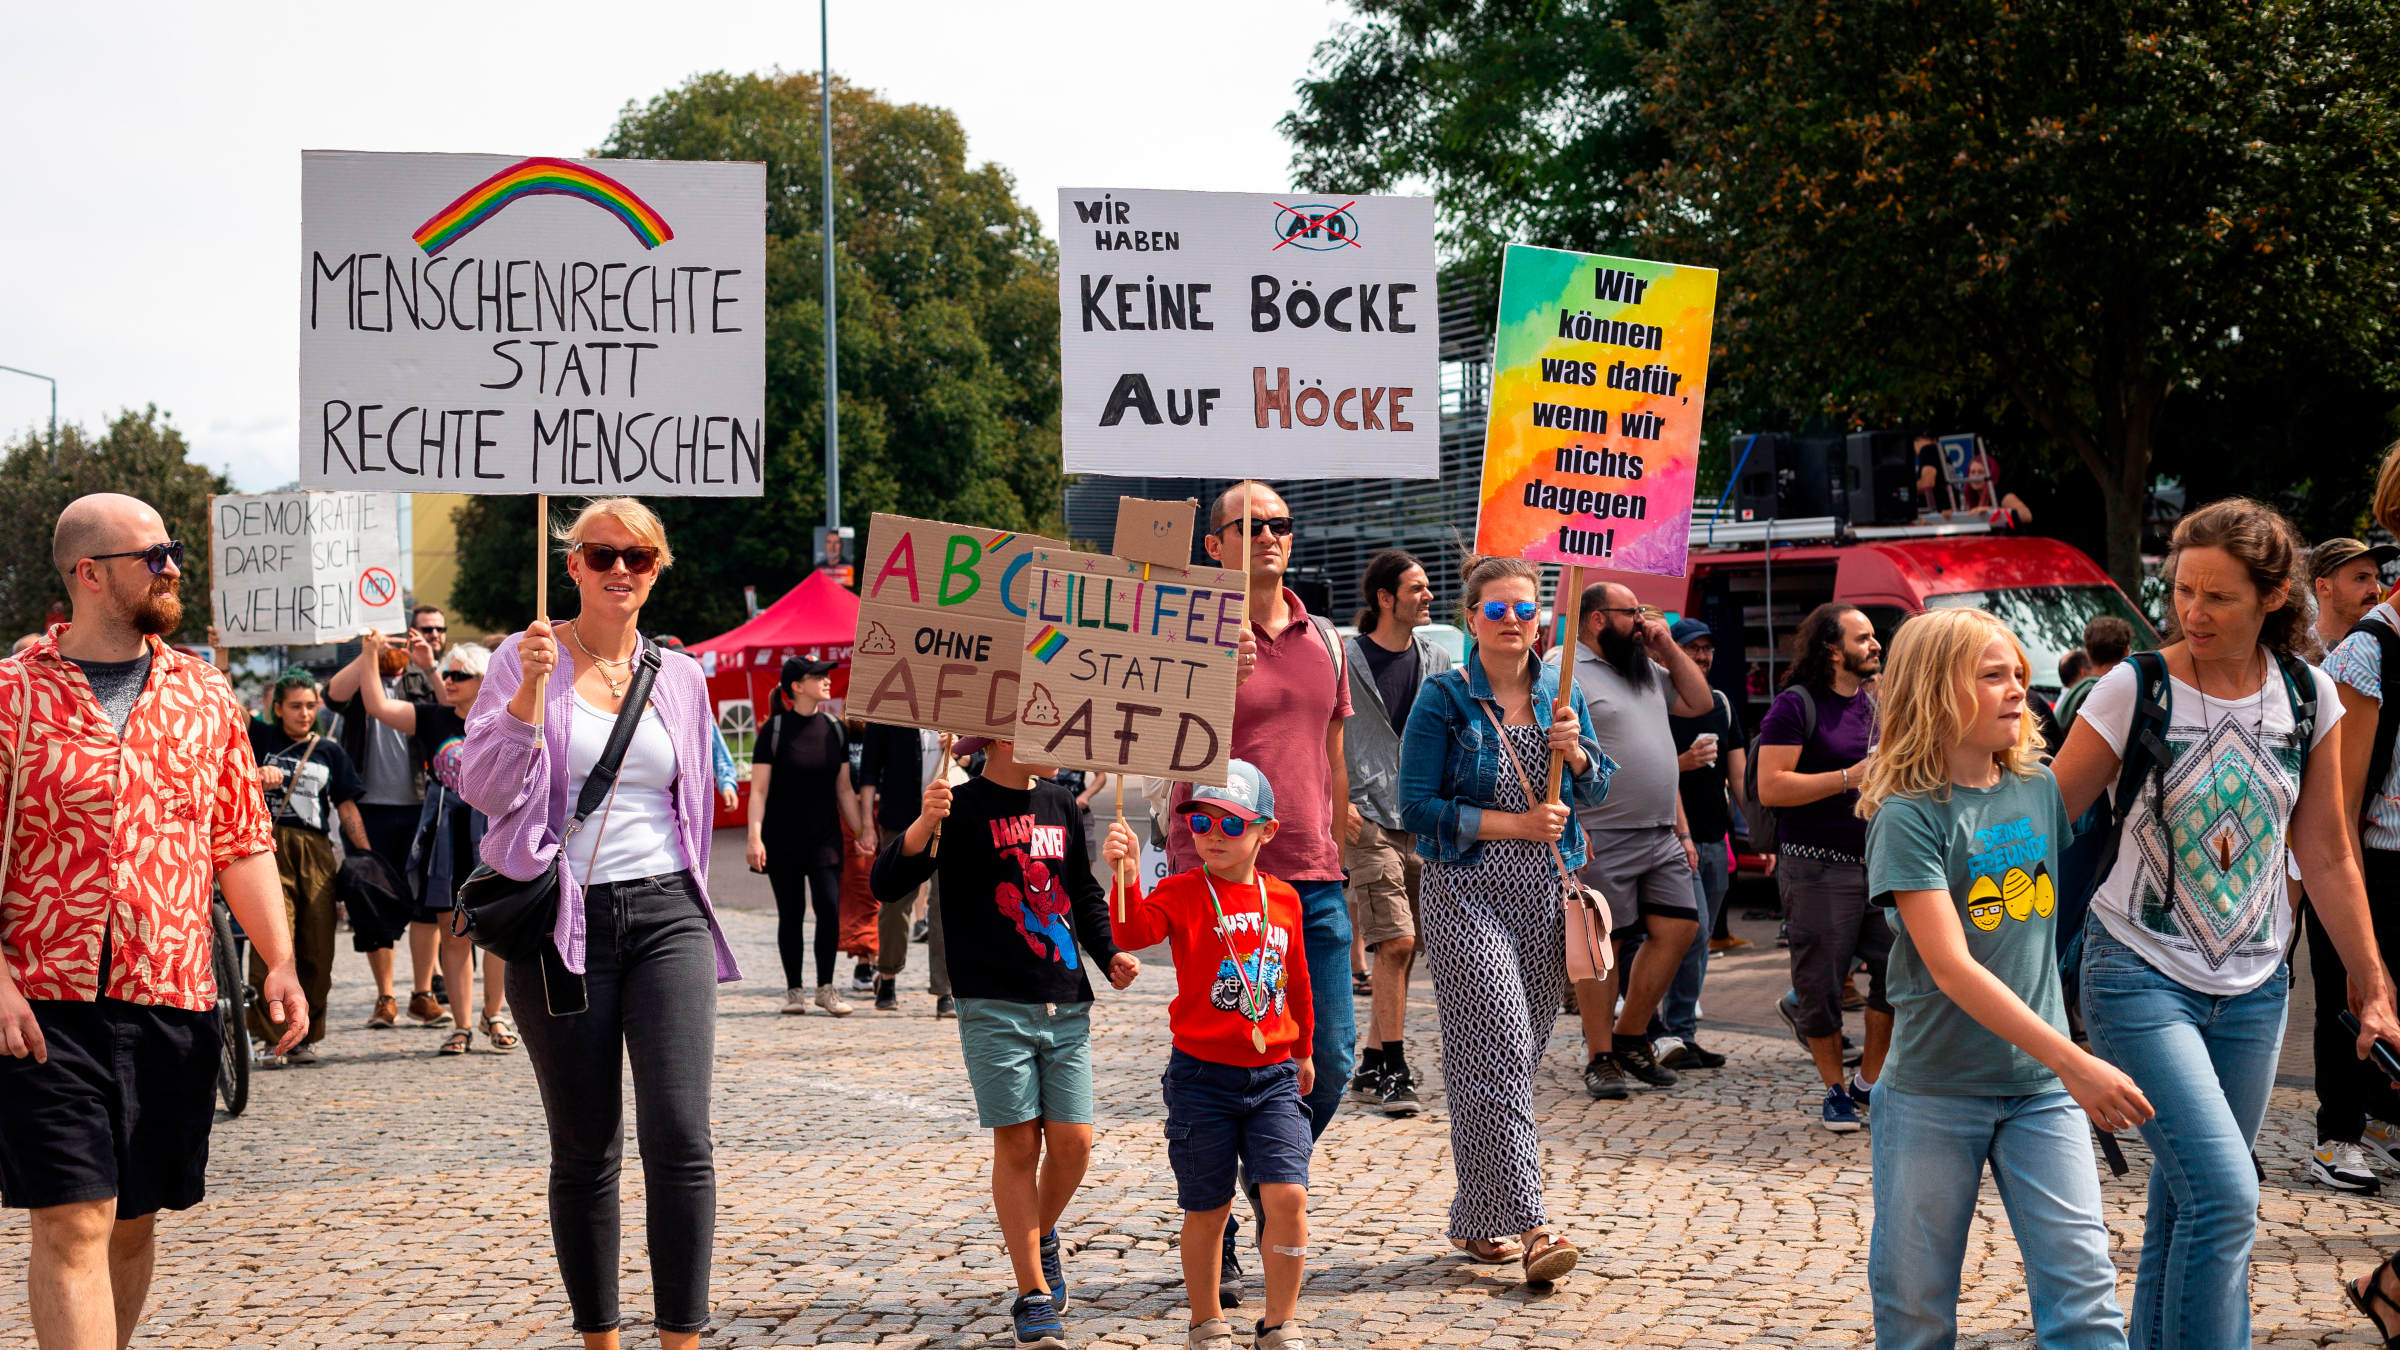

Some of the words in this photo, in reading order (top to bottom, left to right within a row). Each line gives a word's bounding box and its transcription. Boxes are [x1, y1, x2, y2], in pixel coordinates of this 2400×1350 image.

[1095, 230, 1180, 252] HABEN
[1285, 212, 1347, 242] AFD
[311, 250, 742, 333] MENSCHENRECHTE
[1250, 274, 1418, 333] BÖCKE
[1595, 267, 1648, 305] Wir
[1558, 308, 1663, 351] können
[480, 340, 659, 398] STATT
[1541, 357, 1597, 386] was
[1606, 360, 1689, 406] dafür,
[1098, 372, 1221, 427] AUF
[1252, 366, 1414, 432] HÖCKE
[1532, 401, 1608, 435] wenn
[1621, 410, 1666, 441] wir
[323, 399, 505, 479] RECHTE
[532, 408, 761, 485] MENSCHEN
[1555, 444, 1644, 480] nichts
[220, 494, 379, 540] DEMOKRATIE
[1523, 478, 1647, 520] dagegen
[225, 544, 295, 576] DARF
[312, 537, 361, 570] SICH
[1559, 525, 1615, 558] tun!
[870, 531, 1033, 618] ABC
[222, 580, 353, 632] WEHREN
[1039, 569, 1245, 649] LILLIFEE
[914, 627, 993, 662] OHNE
[866, 656, 1021, 726] AFD
[1070, 648, 1208, 699] STATT
[1043, 697, 1219, 771] AFD
[1974, 816, 2034, 854] DEINE
